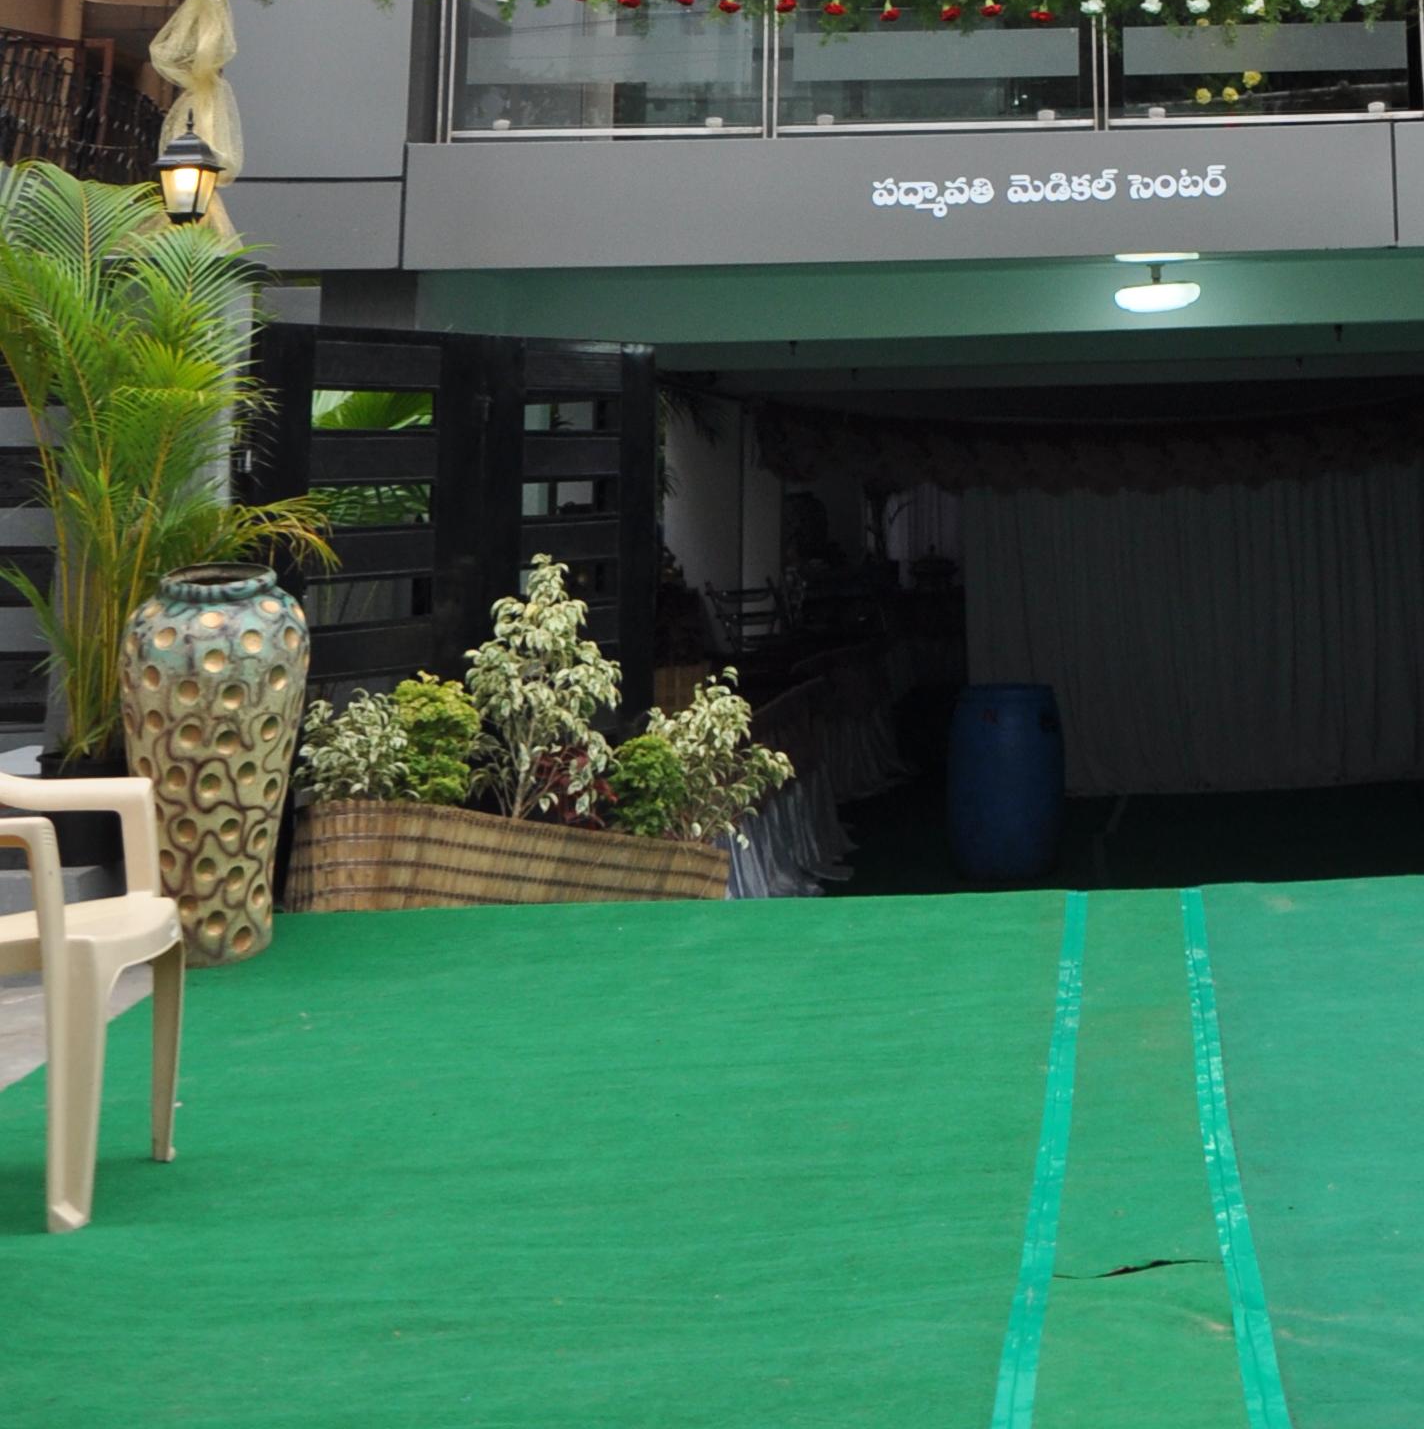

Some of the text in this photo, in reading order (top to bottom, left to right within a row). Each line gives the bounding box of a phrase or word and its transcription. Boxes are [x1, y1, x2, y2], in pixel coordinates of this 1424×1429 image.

[871, 164, 1228, 218] పద్మావతి మెడికల్ సెంటర్
